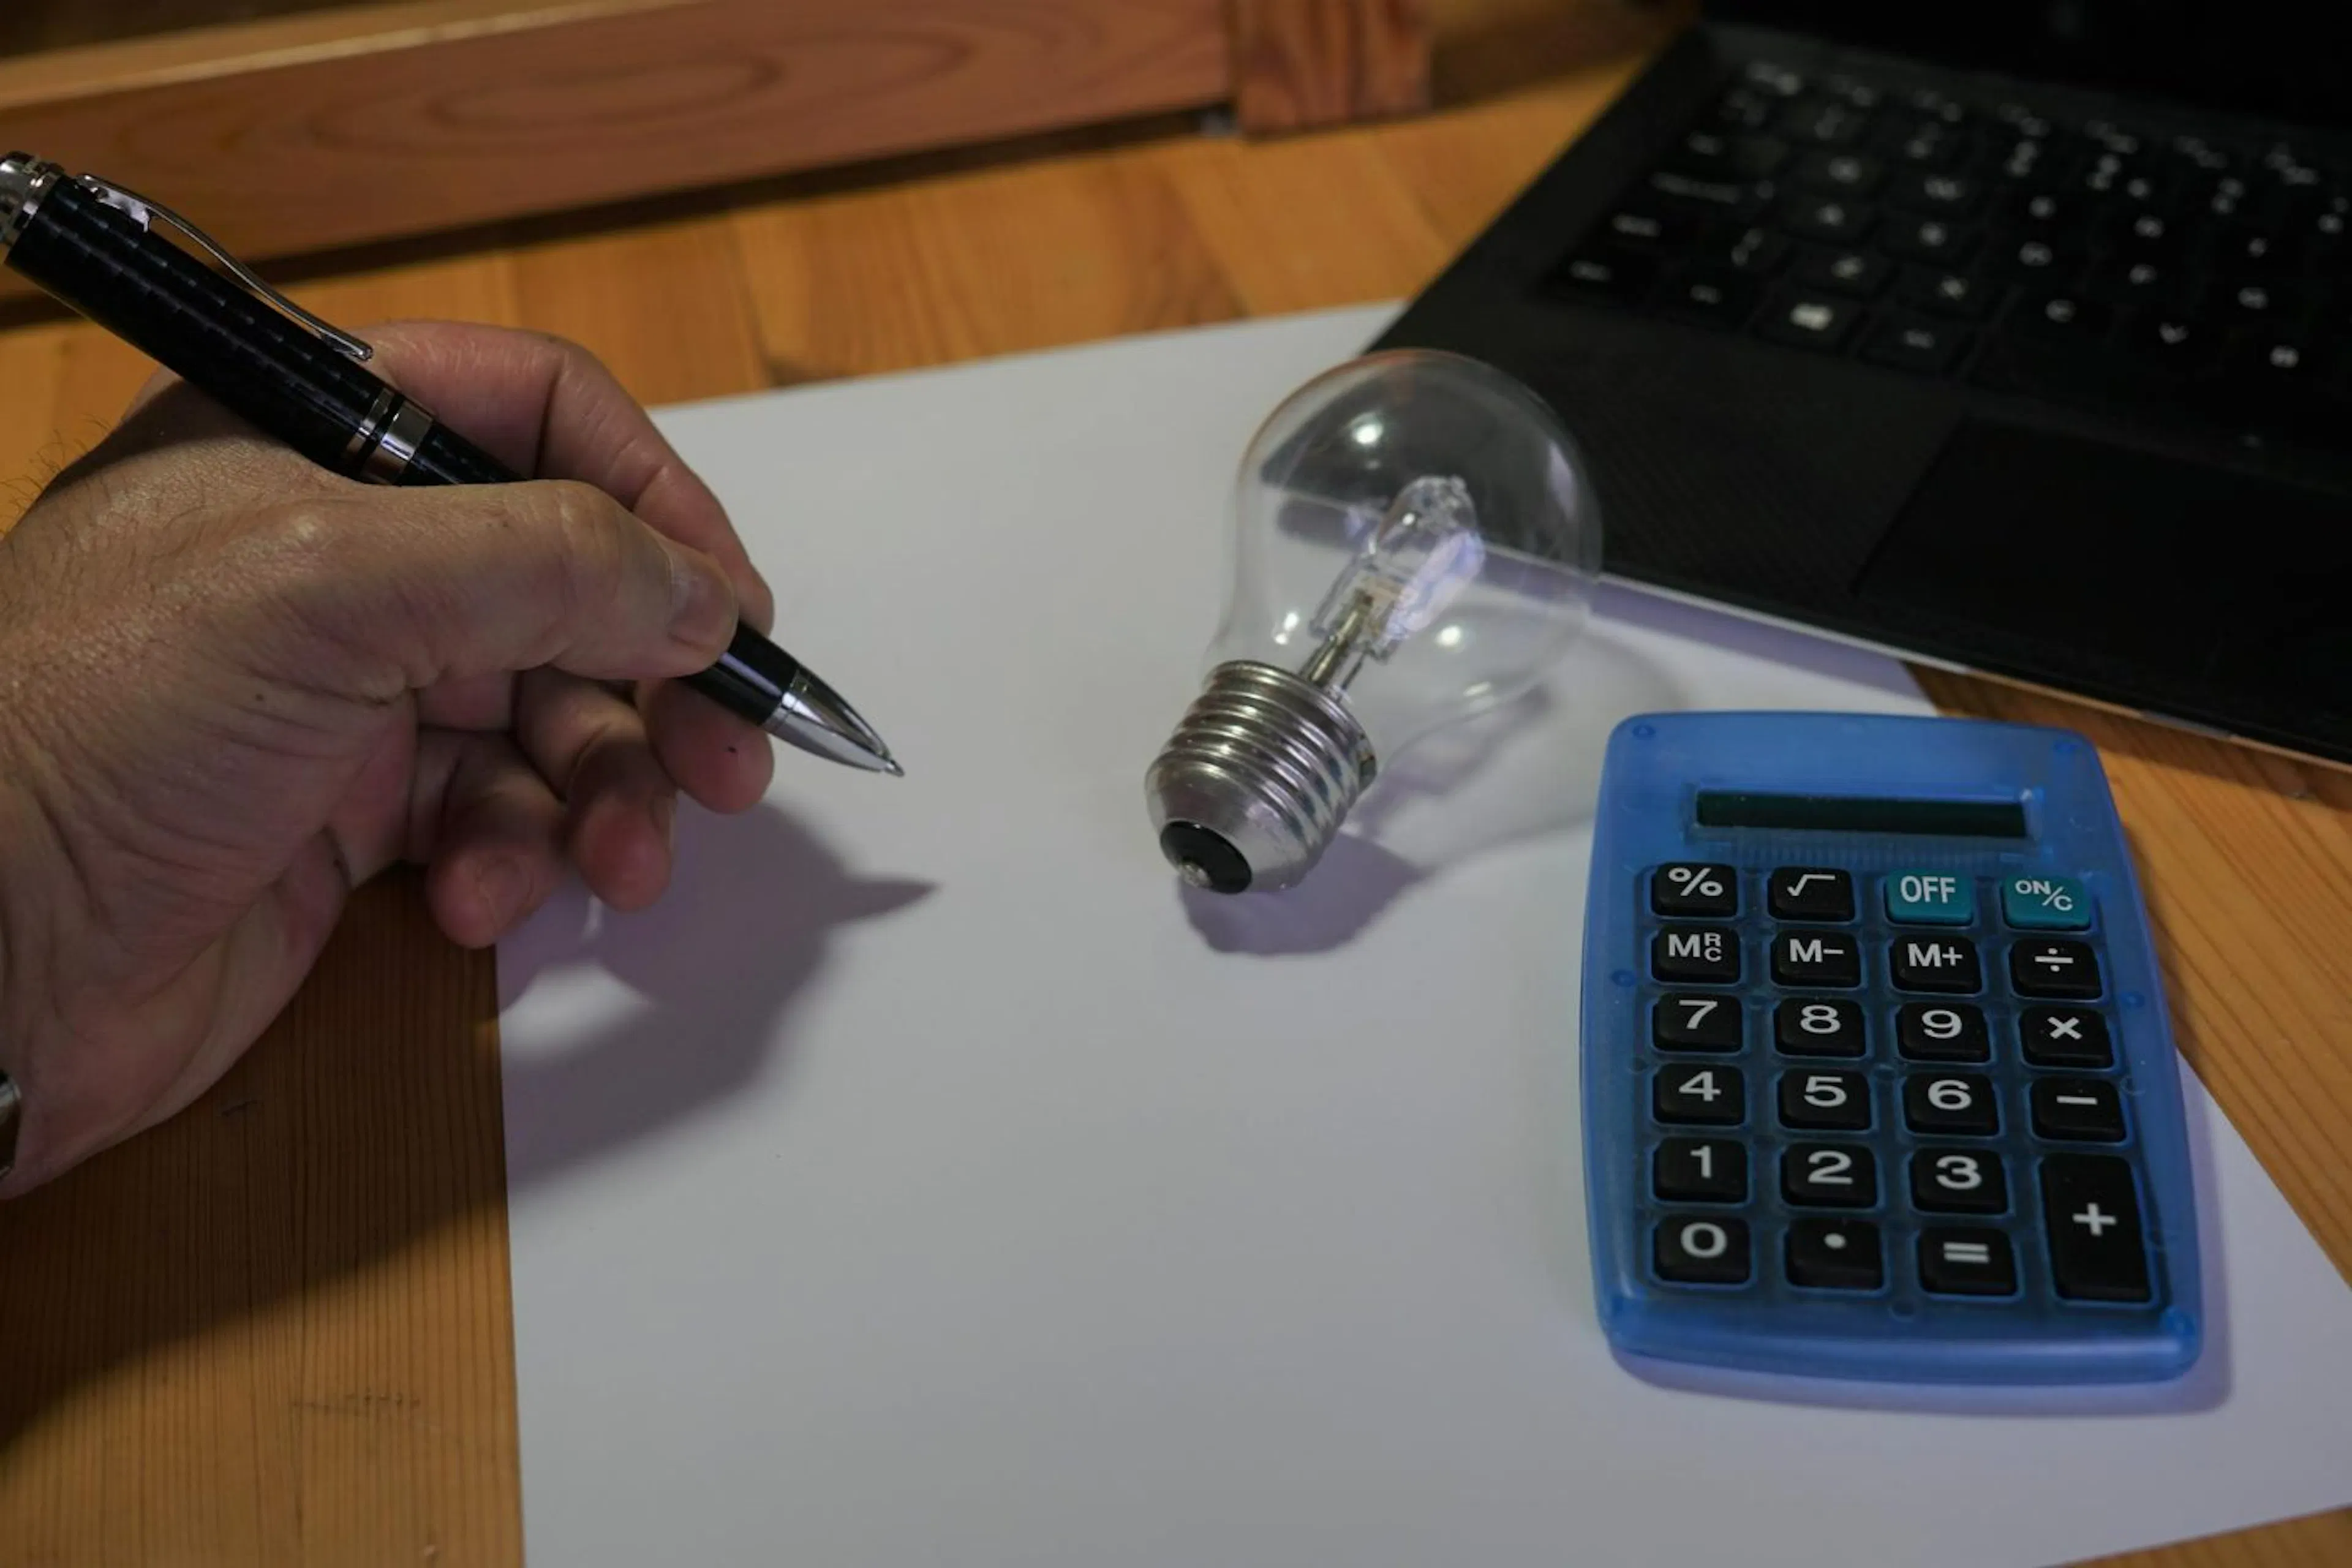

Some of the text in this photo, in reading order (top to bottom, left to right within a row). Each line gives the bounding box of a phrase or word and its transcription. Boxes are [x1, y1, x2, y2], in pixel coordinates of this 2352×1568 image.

[1669, 869, 1723, 896] %
[1901, 876, 1954, 903] OFF
[1908, 943, 1962, 967] M+
[1679, 1000, 1717, 1029] 7
[1801, 1005, 1840, 1033] 8
[1922, 1010, 1962, 1038] 9
[1678, 1071, 1721, 1101] 4
[1804, 1076, 1846, 1106] 5
[1928, 1080, 1971, 1109] 6
[1689, 1146, 1711, 1178] 1
[1808, 1152, 1852, 1183] 2
[1937, 1156, 1981, 1188] 3
[2073, 1202, 2116, 1235] +
[1681, 1224, 1726, 1256] 0
[1943, 1242, 1989, 1262] =
